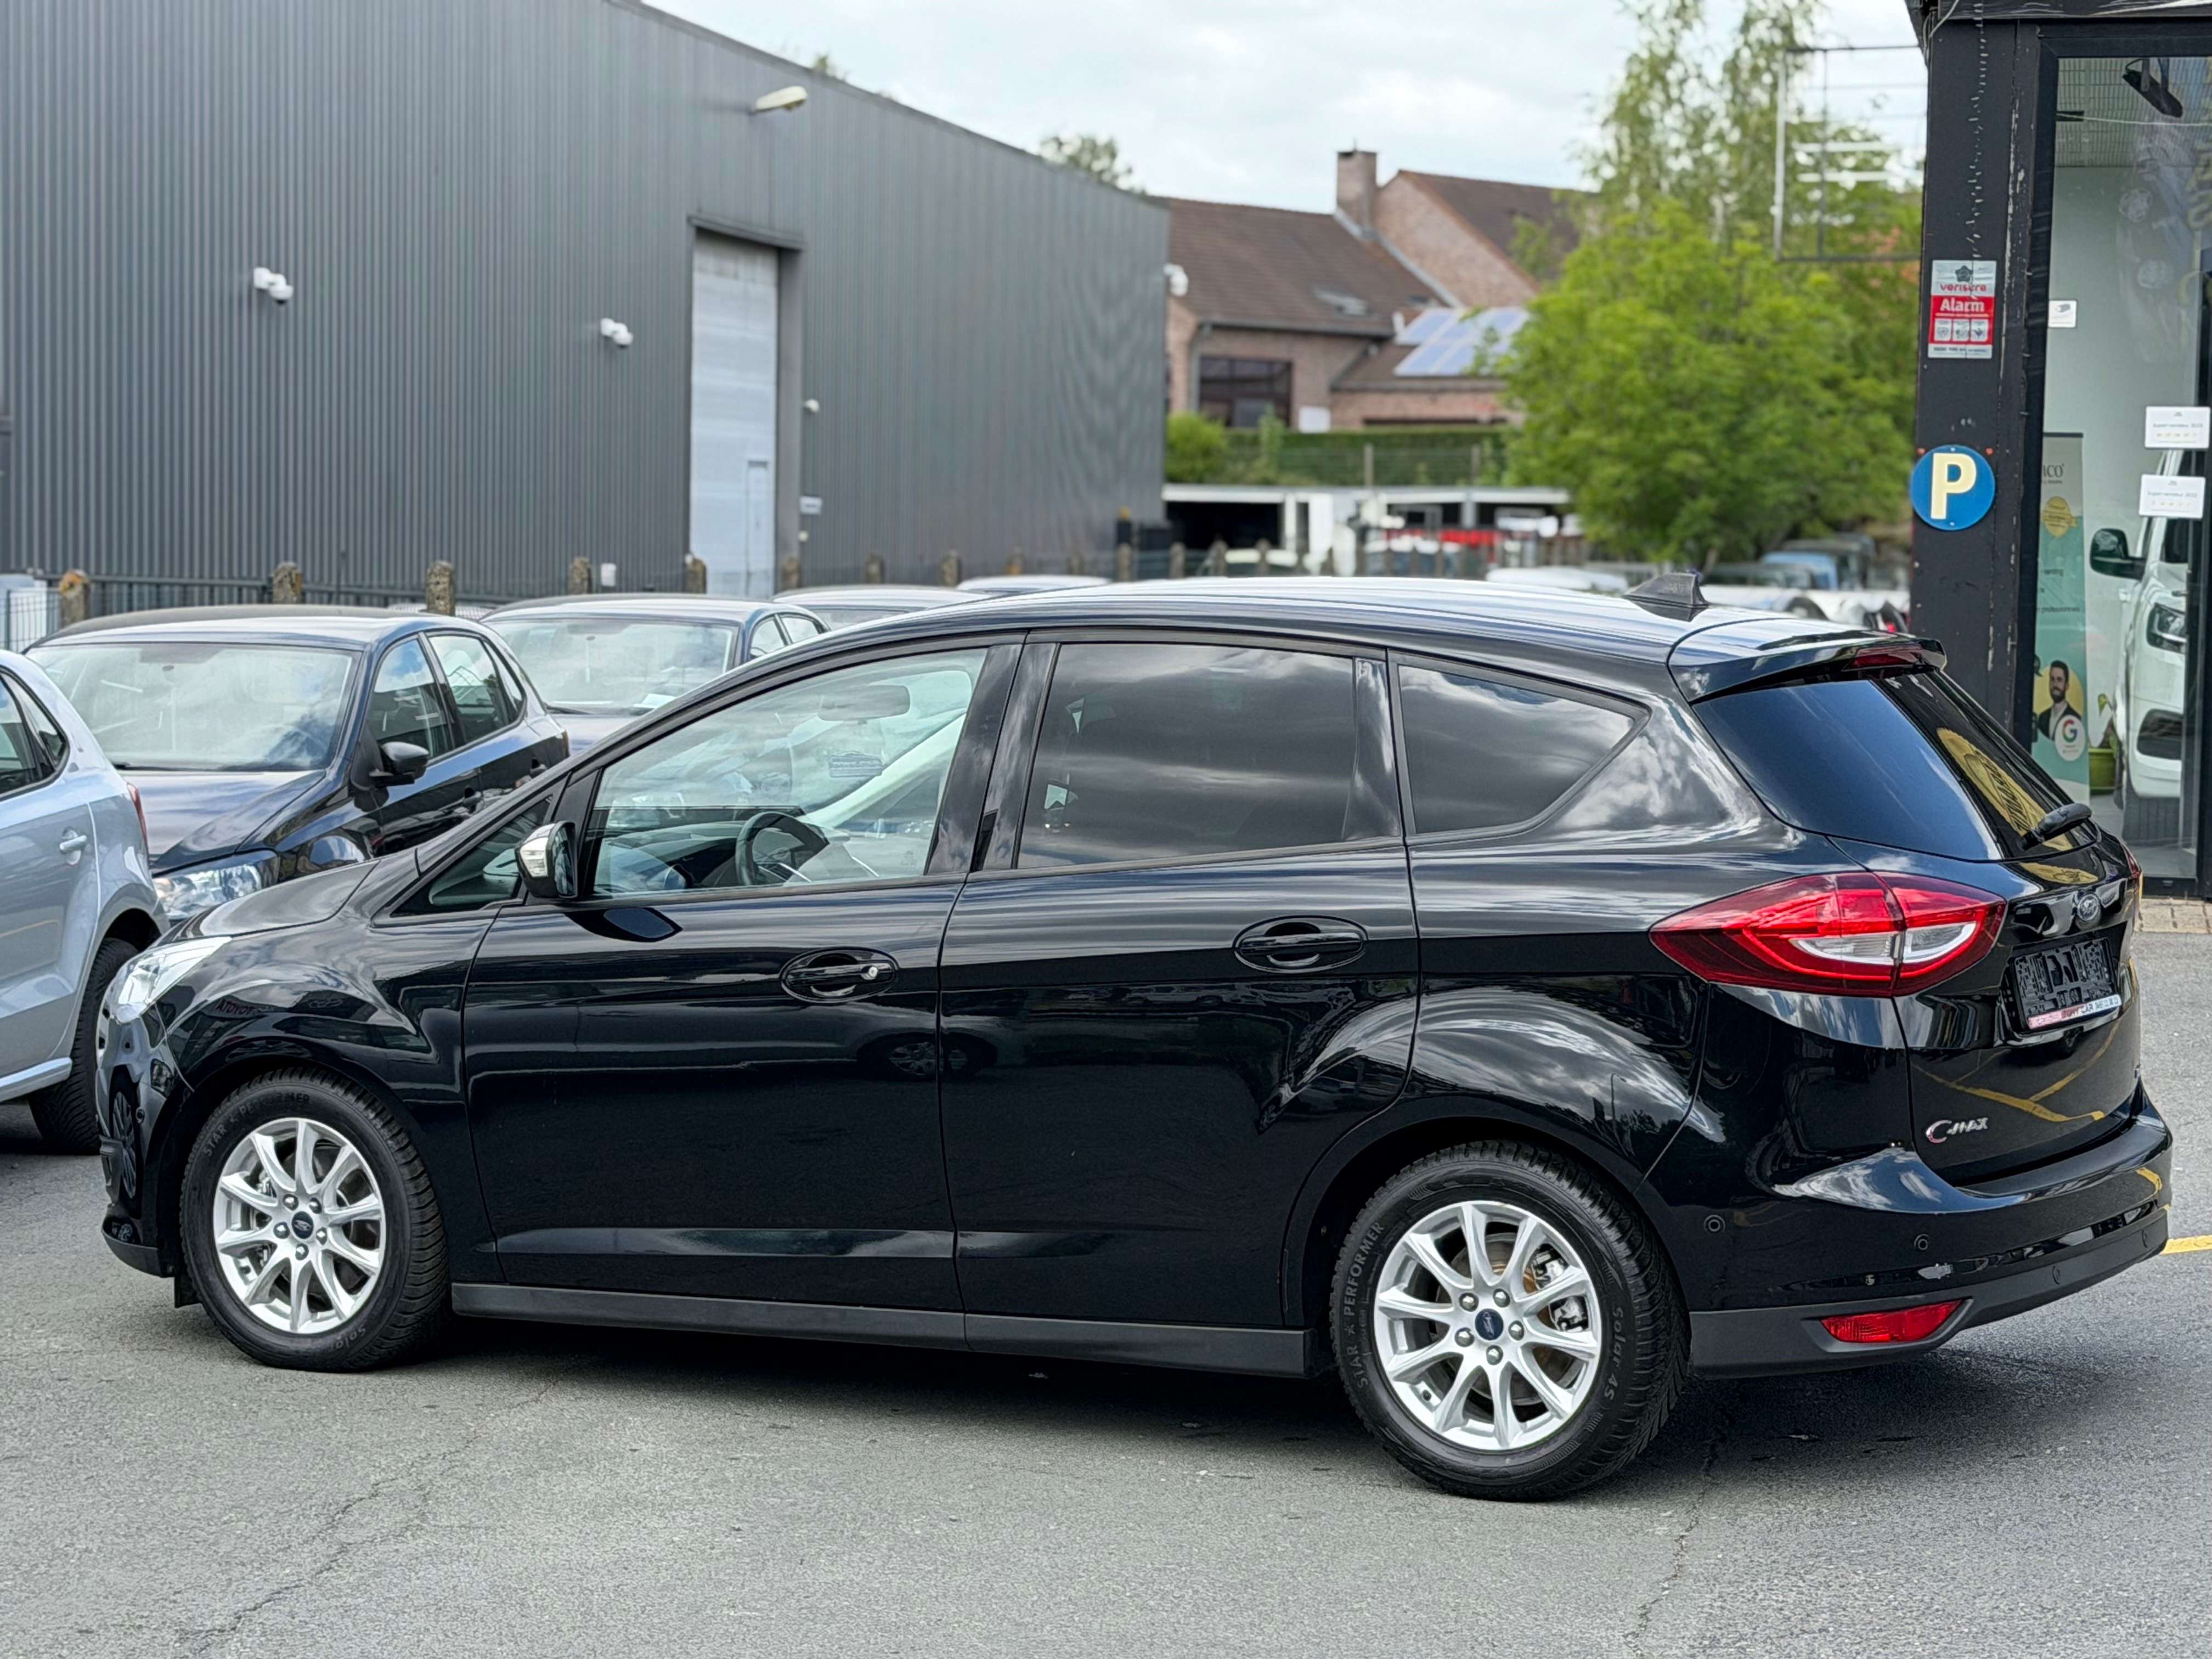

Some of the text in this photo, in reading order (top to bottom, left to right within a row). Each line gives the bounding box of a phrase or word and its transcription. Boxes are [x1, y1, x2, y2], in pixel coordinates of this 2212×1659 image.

[1940, 297, 1985, 312] Alarm
[1930, 452, 1977, 520] P
[2063, 719, 2078, 743] G
[1344, 1221, 1385, 1316] PERFORMER
[1347, 1345, 1369, 1389] STAR
